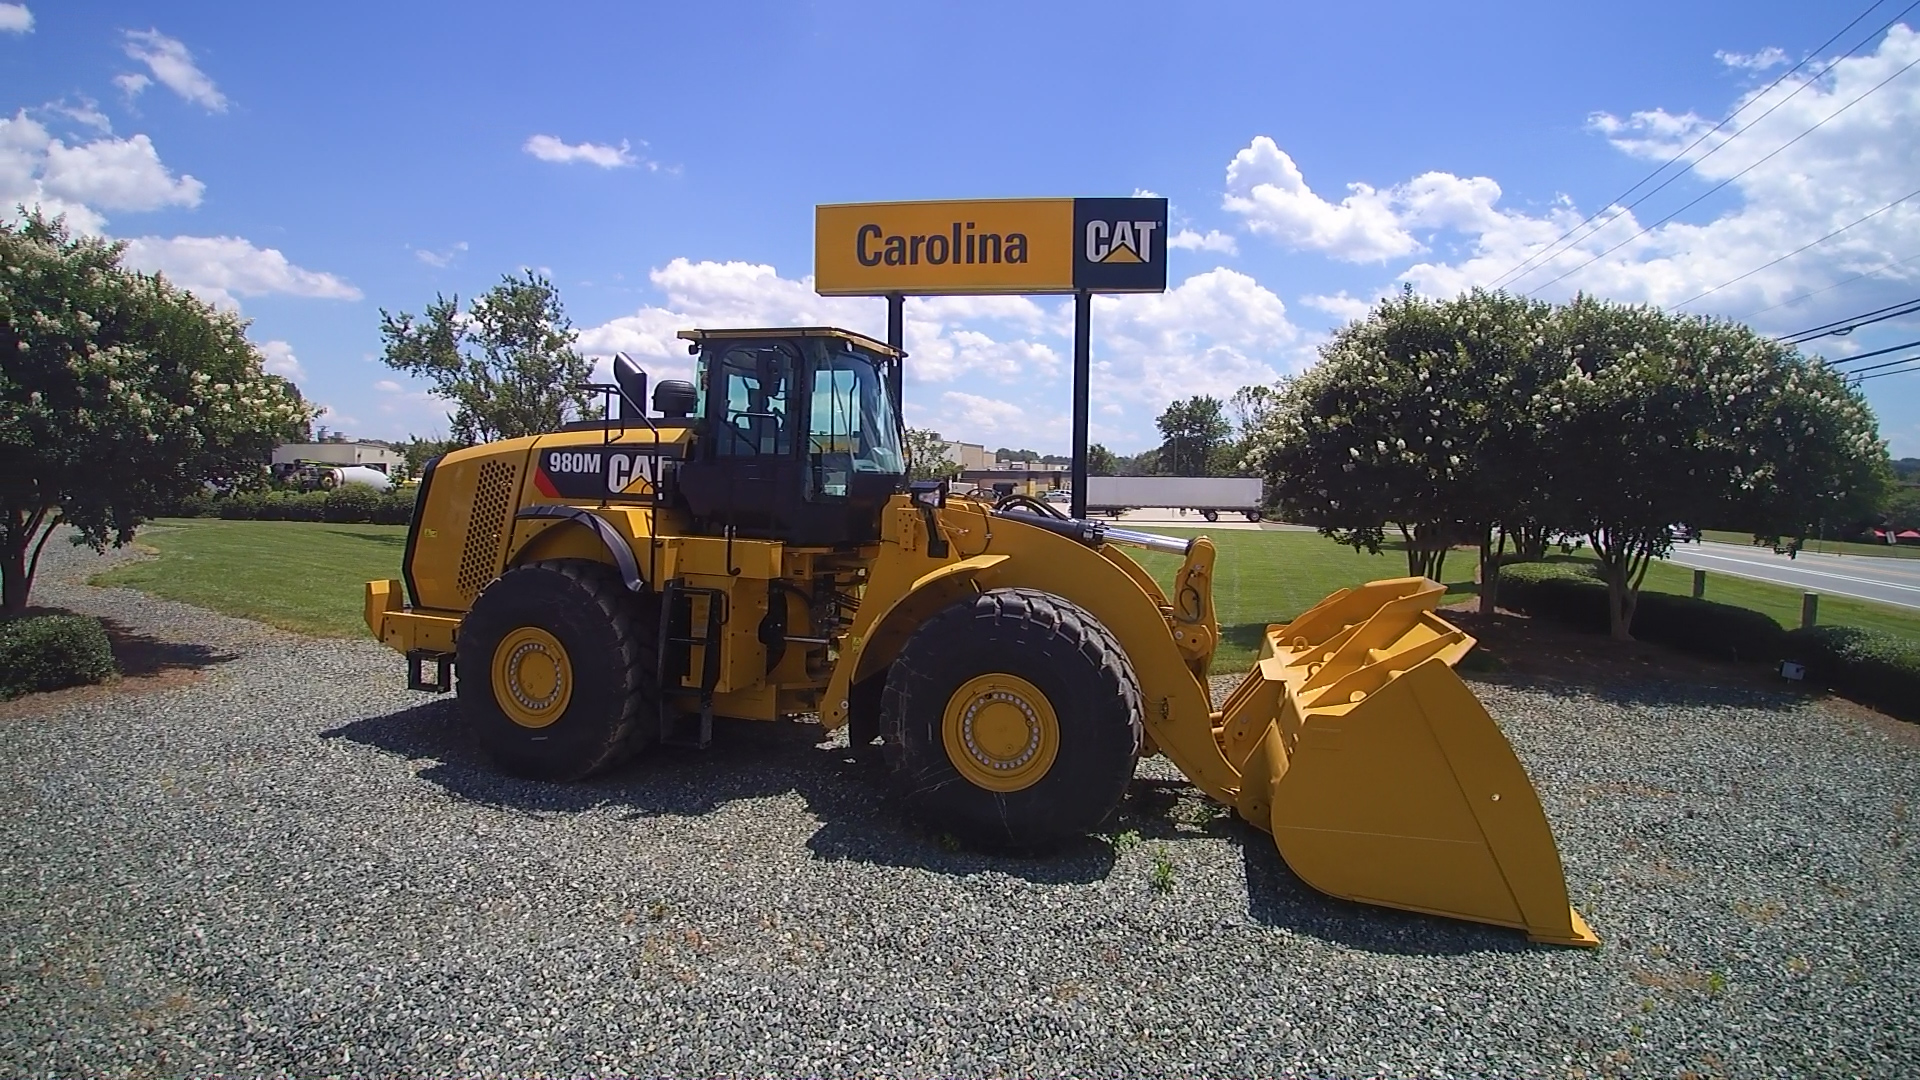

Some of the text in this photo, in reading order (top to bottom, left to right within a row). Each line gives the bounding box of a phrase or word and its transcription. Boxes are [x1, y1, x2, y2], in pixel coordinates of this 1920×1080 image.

[856, 222, 1028, 266] Carolina
[1086, 220, 1157, 263] CAT
[550, 452, 600, 473] 980M
